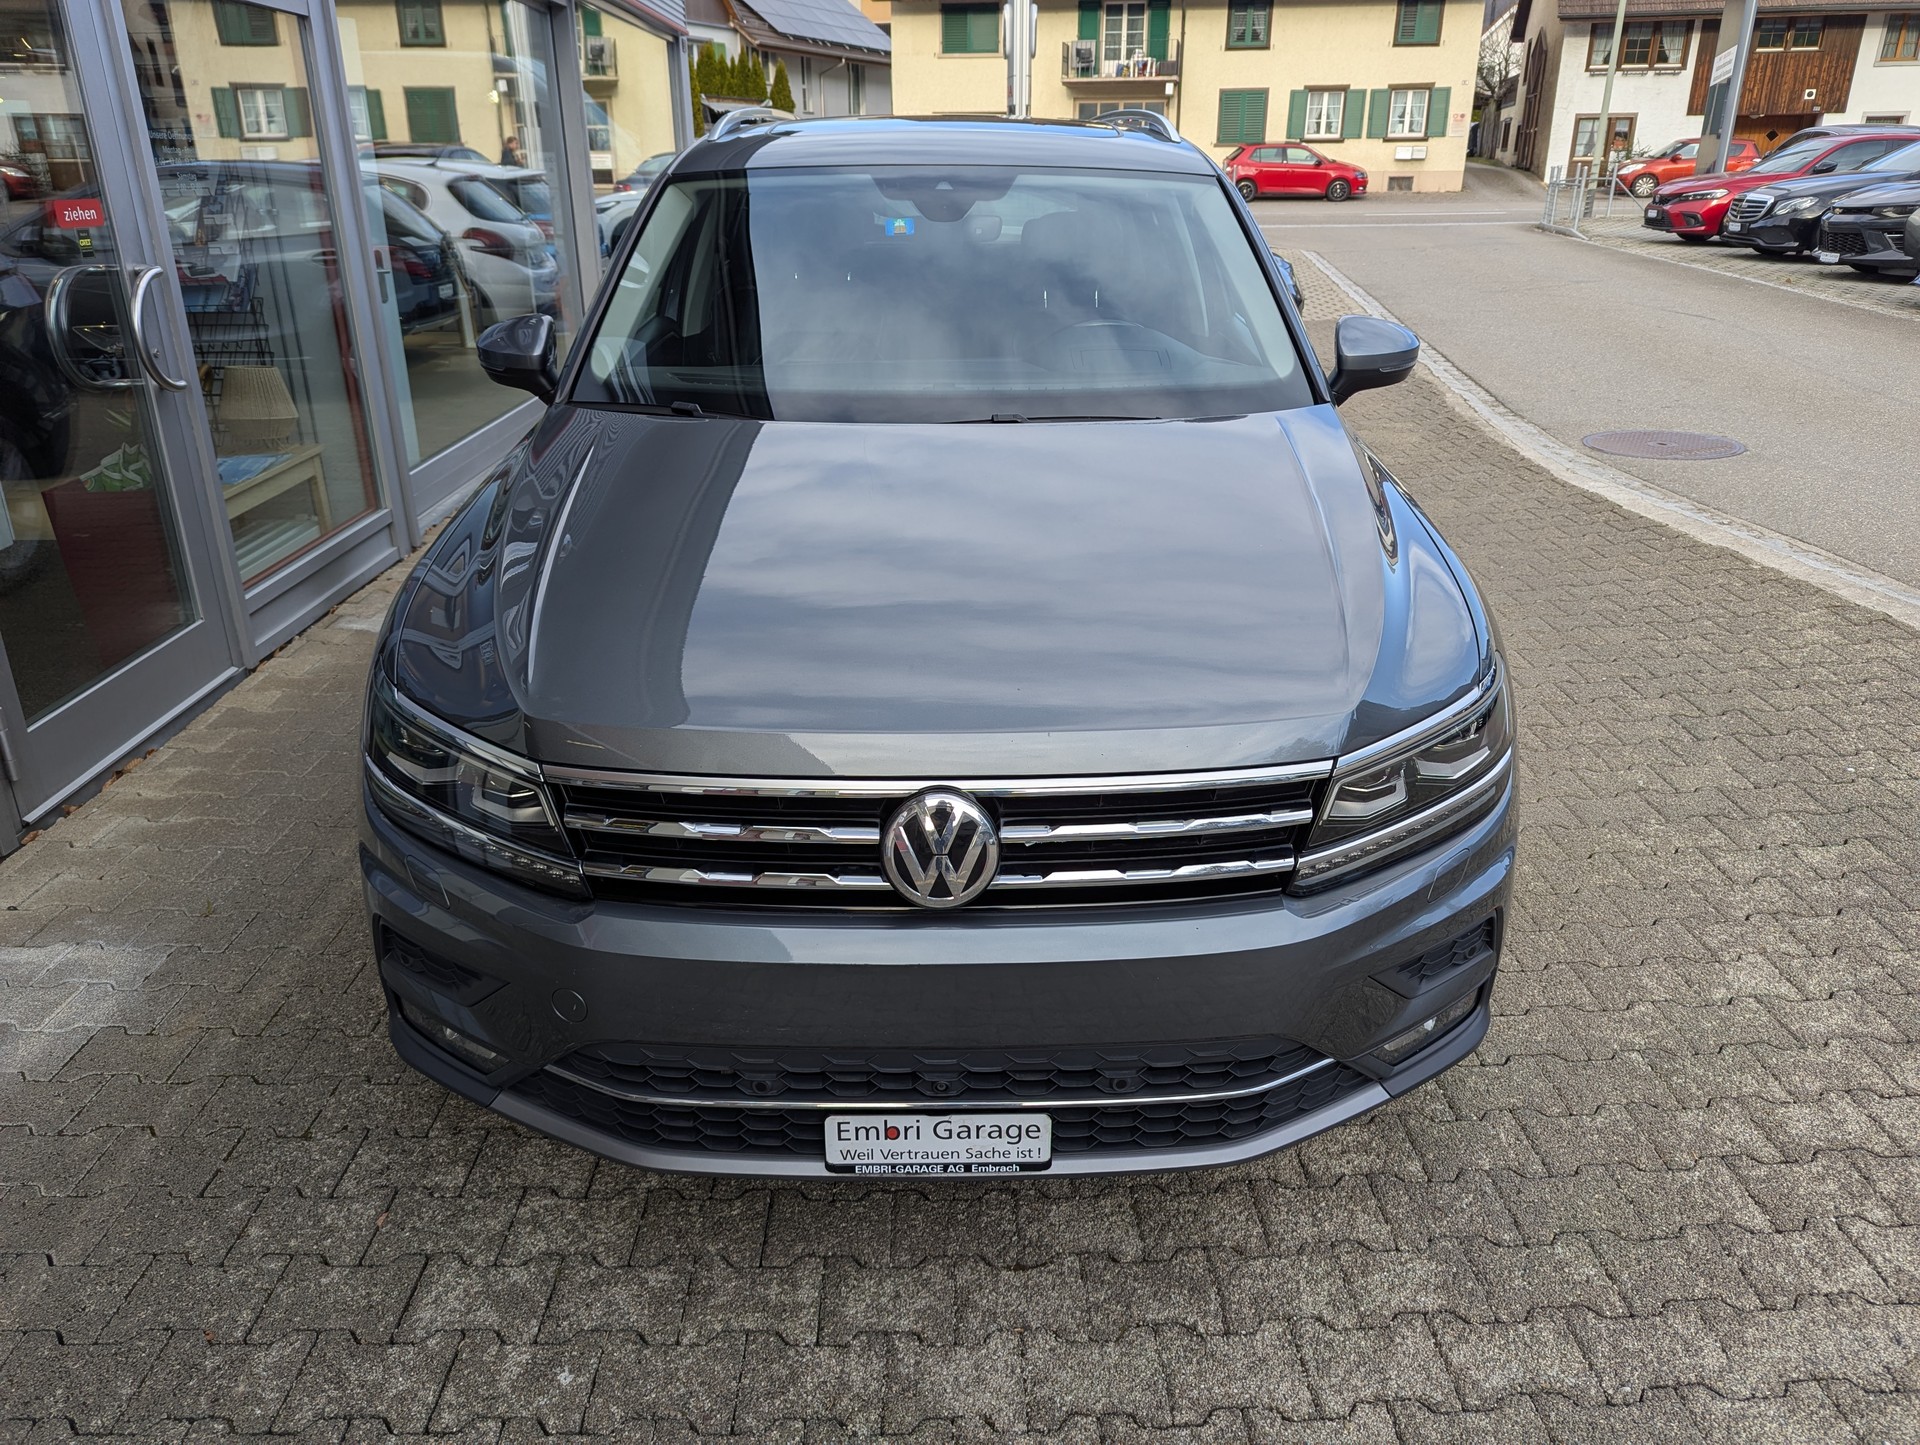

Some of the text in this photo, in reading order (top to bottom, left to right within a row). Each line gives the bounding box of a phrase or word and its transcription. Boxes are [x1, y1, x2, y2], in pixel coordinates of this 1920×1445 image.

[64, 206, 97, 221] ziehen
[837, 1119, 1041, 1145] Embri Garage
[840, 1148, 874, 1161] Weil
[880, 1148, 960, 1161] Vertrauen
[965, 1146, 1011, 1160] Sache
[855, 1163, 1020, 1174] EMBRI-GARAGE AG Embrach
